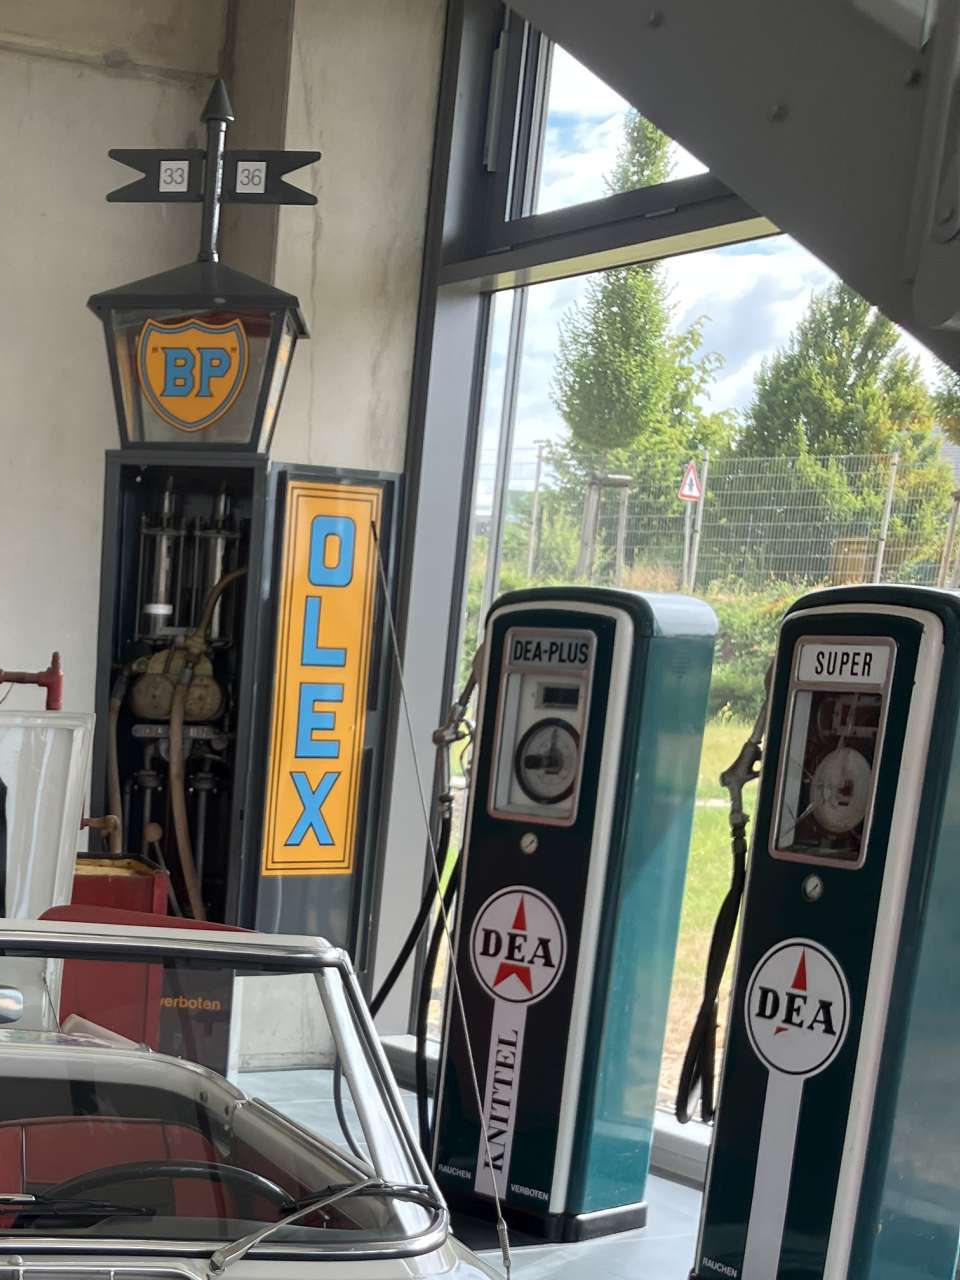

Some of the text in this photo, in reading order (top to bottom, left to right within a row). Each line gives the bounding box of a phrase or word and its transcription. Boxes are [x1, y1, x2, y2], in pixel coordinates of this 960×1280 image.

[162, 167, 185, 185] 33
[239, 168, 263, 186] 36
[513, 640, 590, 664] DEA-PLUS
[815, 651, 873, 676] SUPER
[284, 514, 357, 846] OLEX
[479, 927, 556, 969] DEA
[755, 986, 837, 1036] DEA
[484, 1029, 519, 1174] KNITTEL
[438, 1164, 549, 1201] RAUCHEN VERBOTEN
[702, 1257, 737, 1279] RAUCHEN
